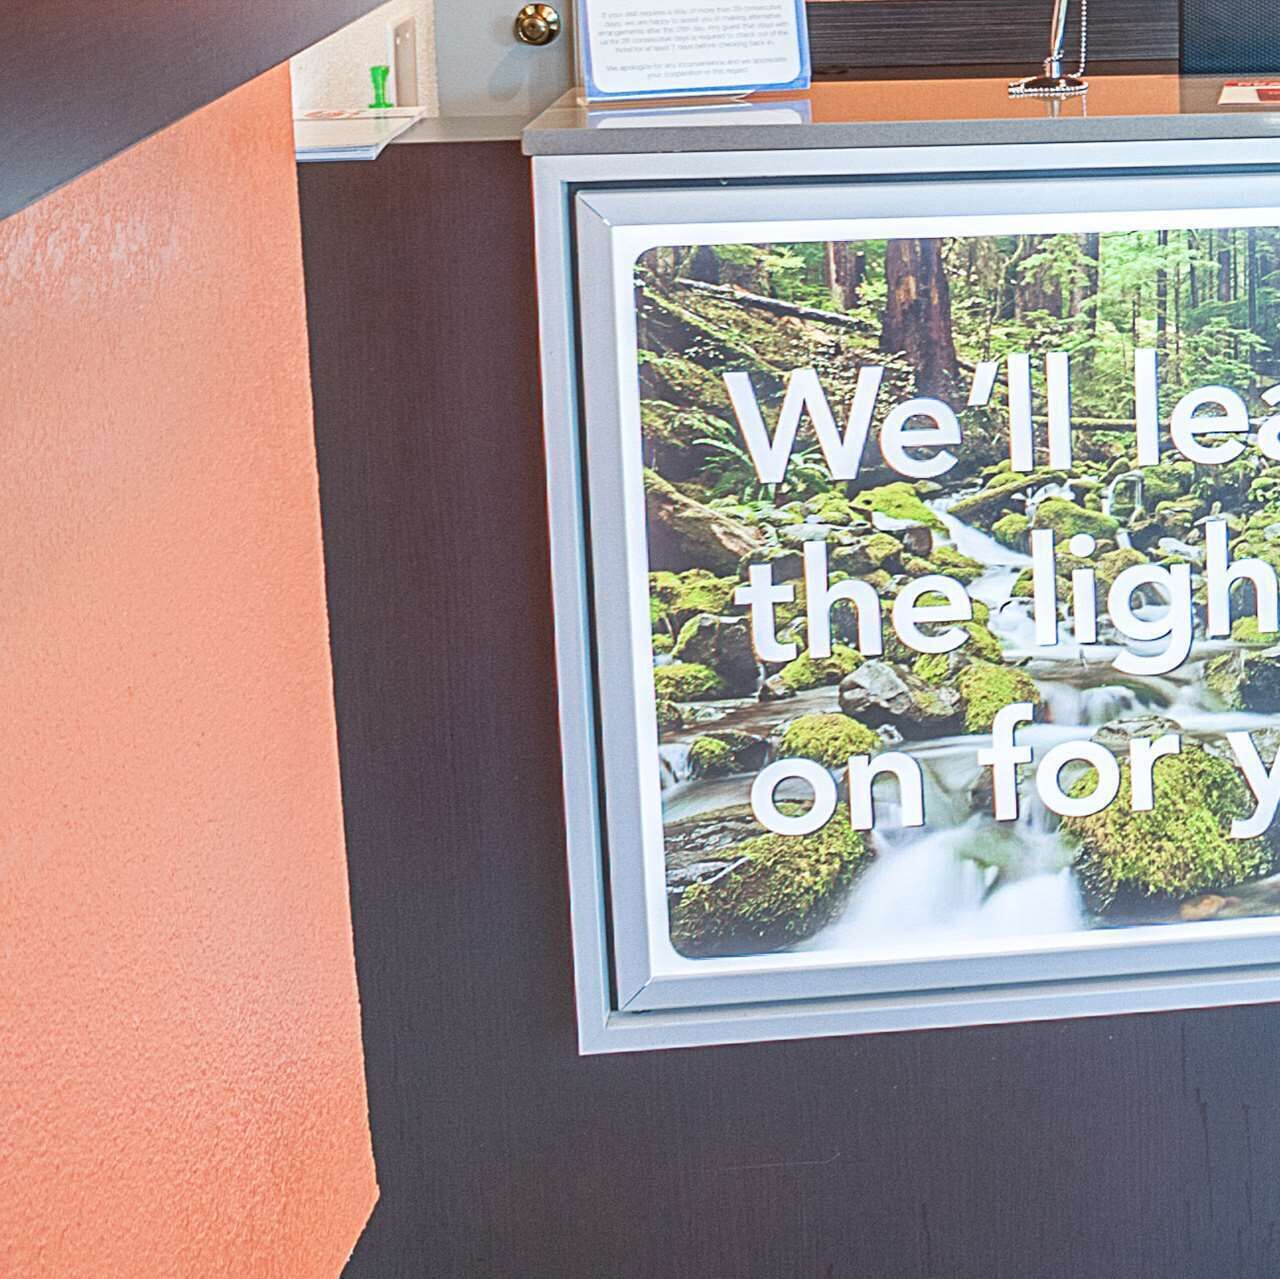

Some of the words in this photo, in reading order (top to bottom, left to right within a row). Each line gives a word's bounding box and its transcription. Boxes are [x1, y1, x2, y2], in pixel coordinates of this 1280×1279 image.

[721, 352, 1074, 484] We'll
[735, 540, 974, 663] the
[749, 751, 925, 837] on
[977, 703, 1183, 822] for
